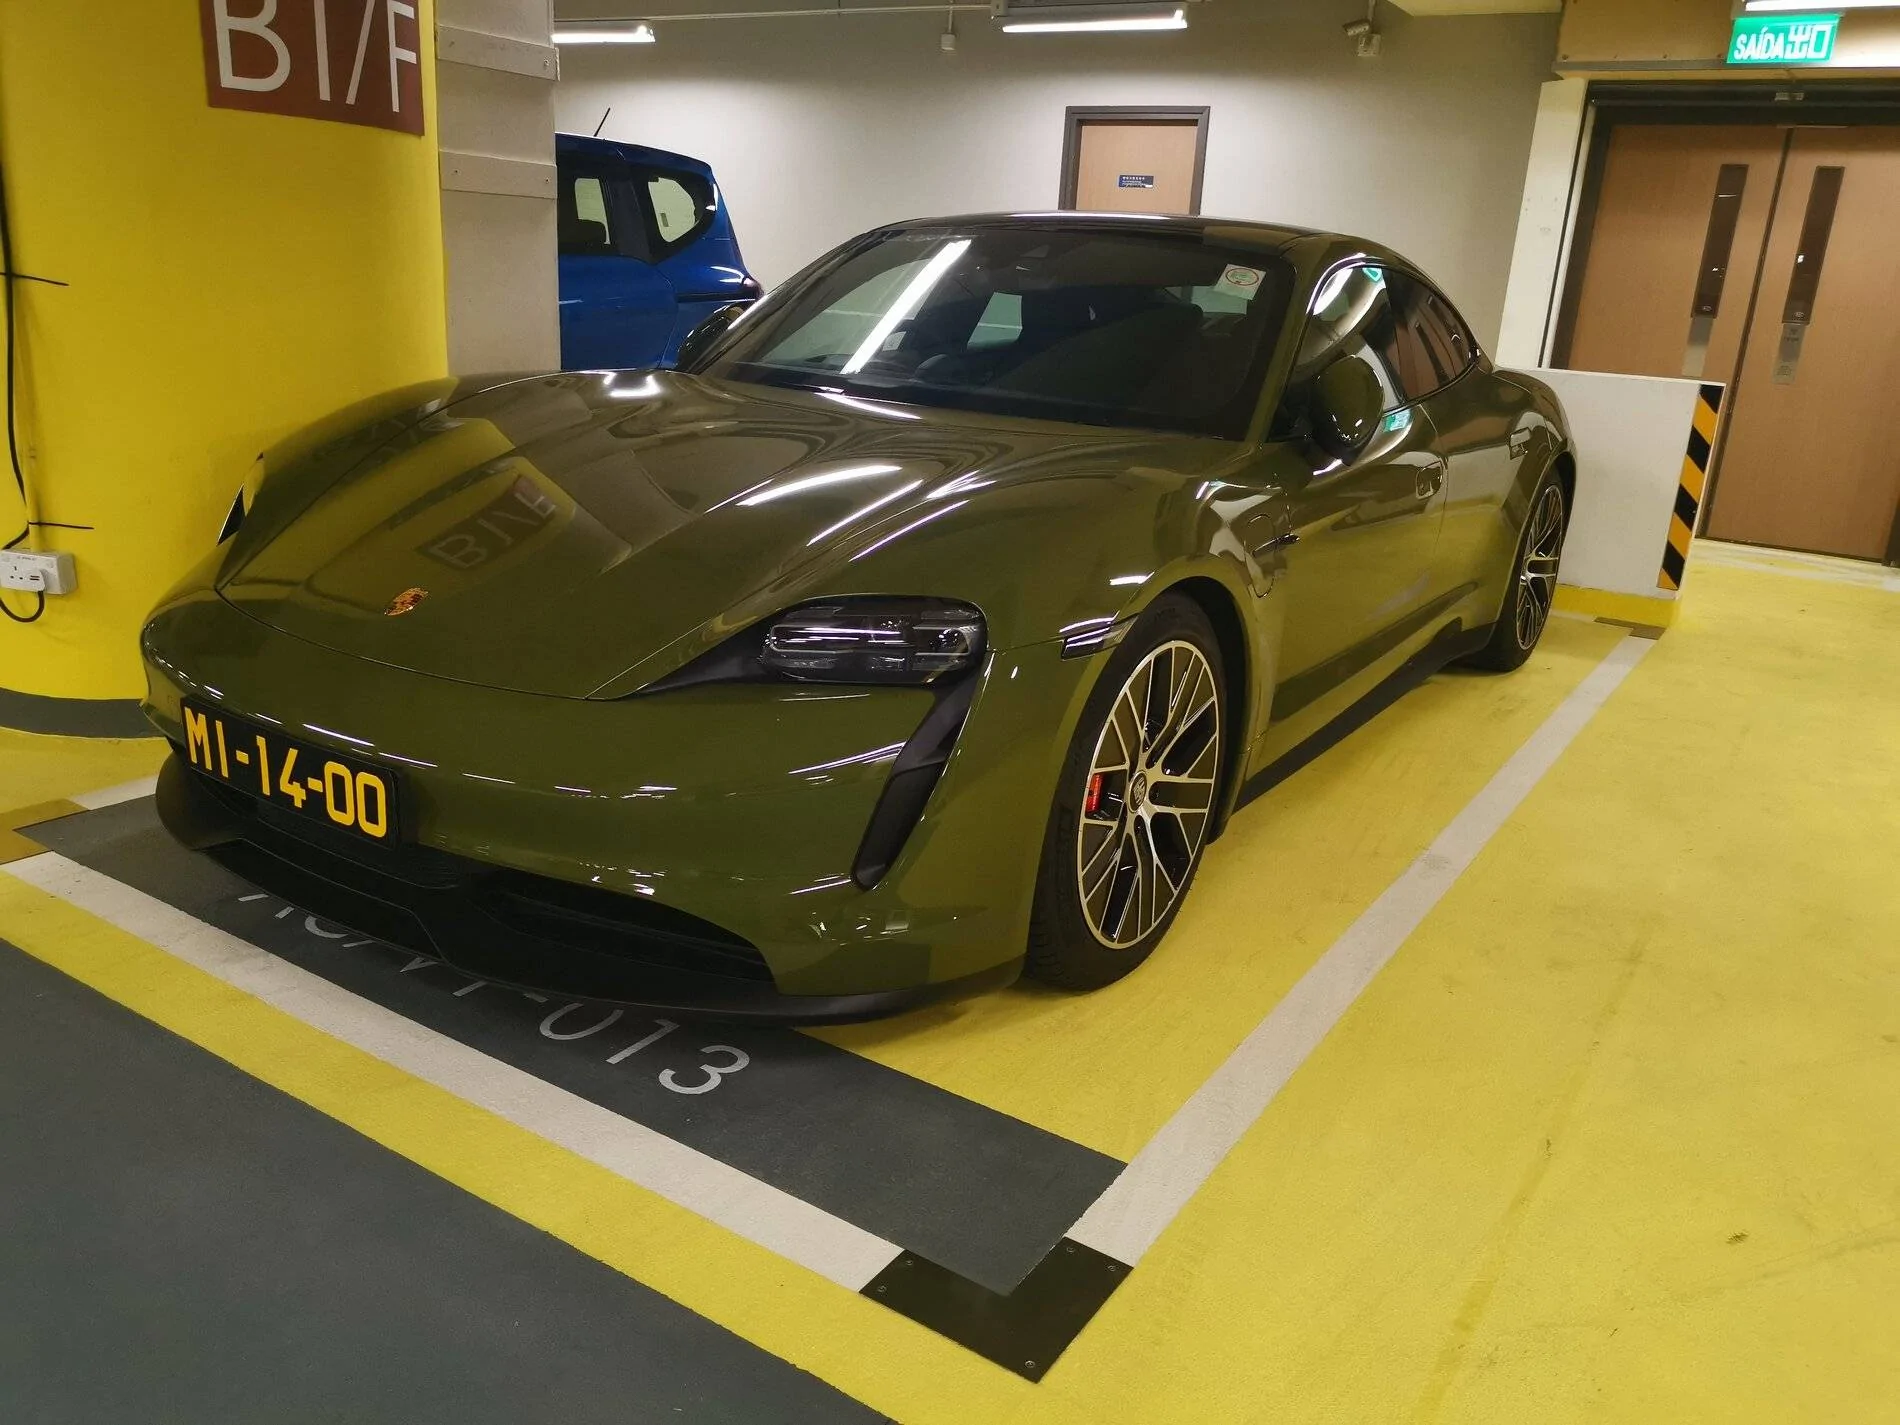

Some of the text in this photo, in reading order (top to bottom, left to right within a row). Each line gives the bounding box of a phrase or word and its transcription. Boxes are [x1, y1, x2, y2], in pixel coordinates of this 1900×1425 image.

[213, 0, 417, 113] B1/F
[1733, 24, 1833, 60] SAÍDA 出口
[184, 706, 387, 838] MI-14-00
